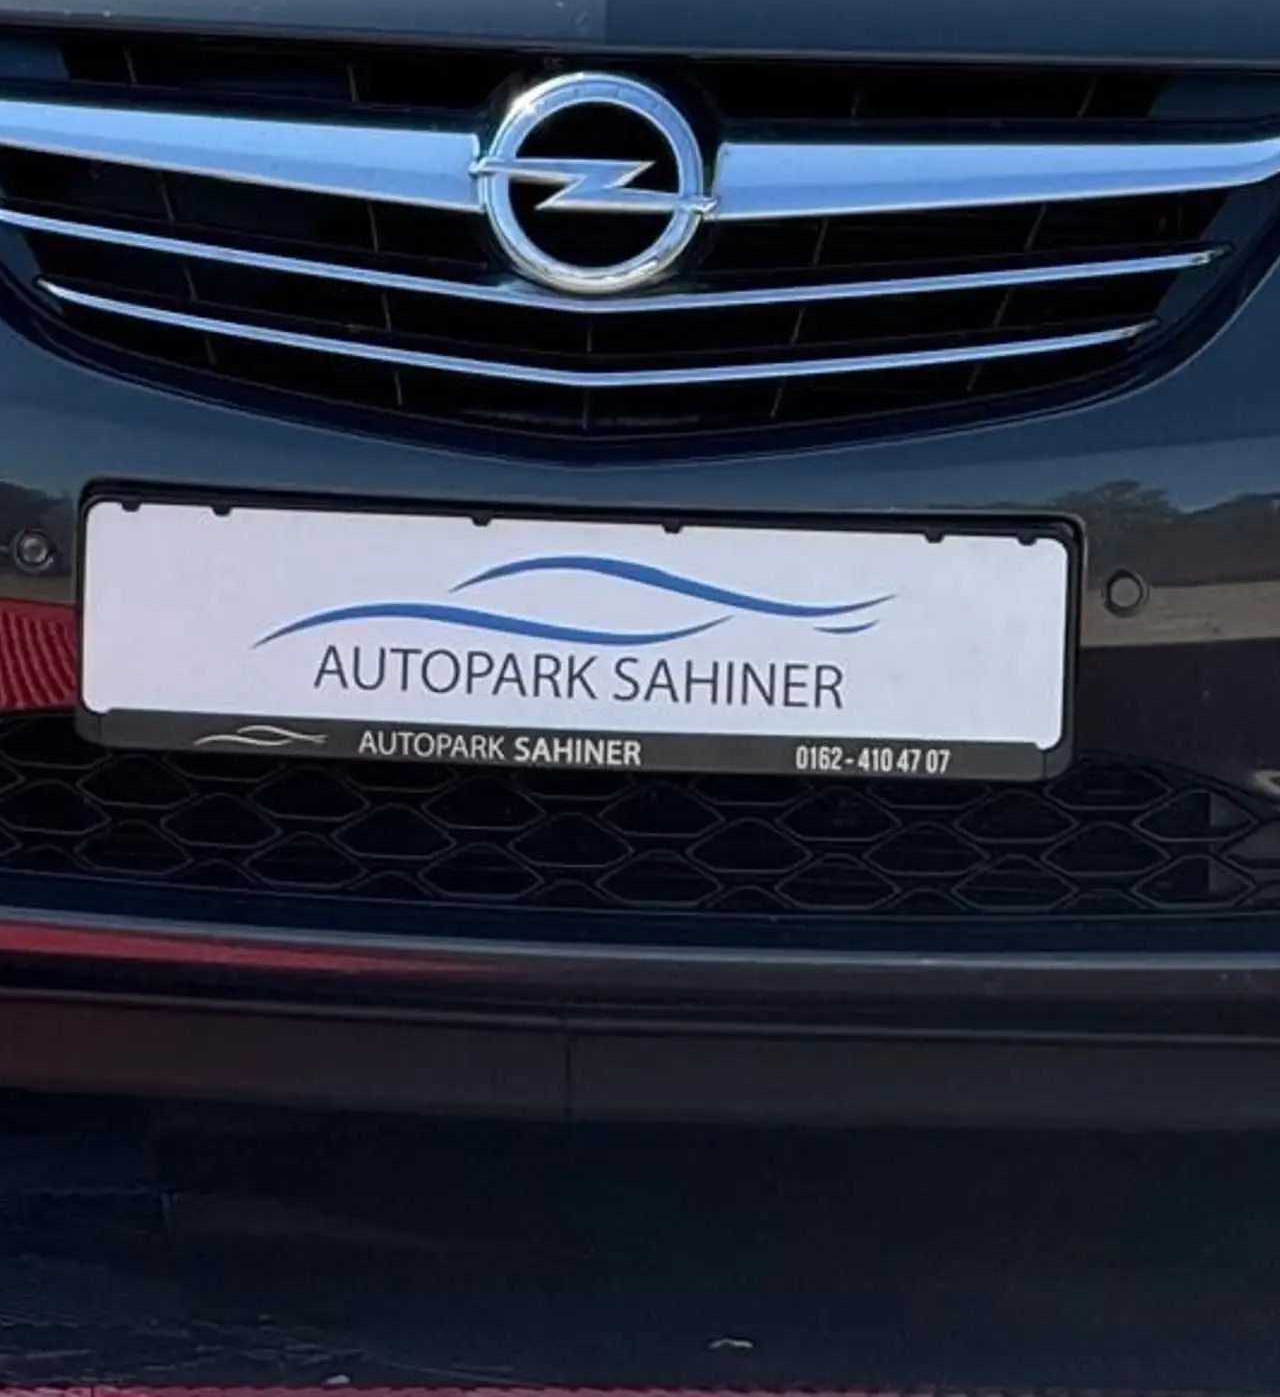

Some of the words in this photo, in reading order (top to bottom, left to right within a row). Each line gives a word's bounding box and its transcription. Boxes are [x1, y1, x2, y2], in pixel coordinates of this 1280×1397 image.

[313, 644, 599, 700] AUTOPARK
[612, 656, 844, 710] SAHINER
[358, 730, 506, 762] AUTOPARK
[514, 736, 642, 767] SAHINER
